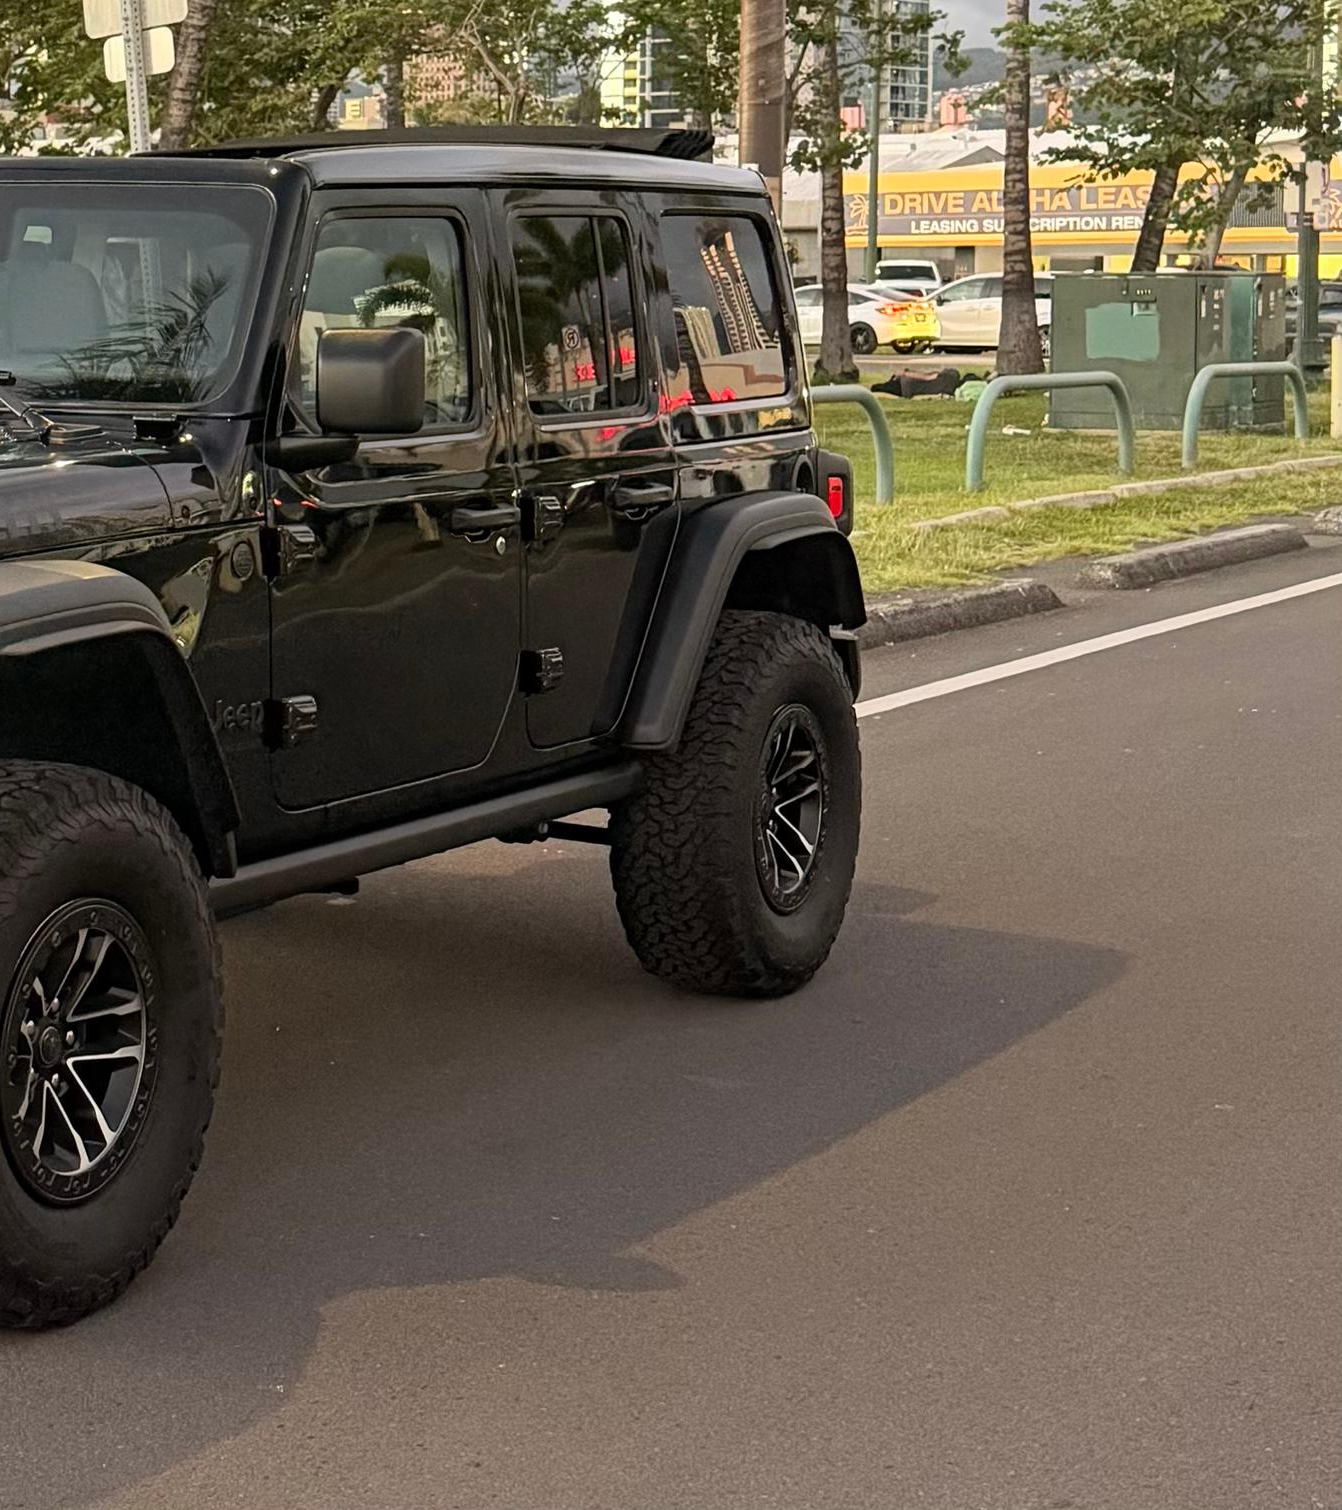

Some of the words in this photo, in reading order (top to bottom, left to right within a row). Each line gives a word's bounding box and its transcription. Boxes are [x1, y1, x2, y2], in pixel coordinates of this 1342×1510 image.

[884, 192, 964, 215] DRIVE
[971, 188, 1072, 213] ALHA
[1080, 186, 1152, 210] LEAS
[910, 219, 980, 234] LEASING
[983, 216, 1108, 233] SUCRIPTION
[1111, 215, 1145, 230] REN
[213, 699, 265, 734] Jeep
